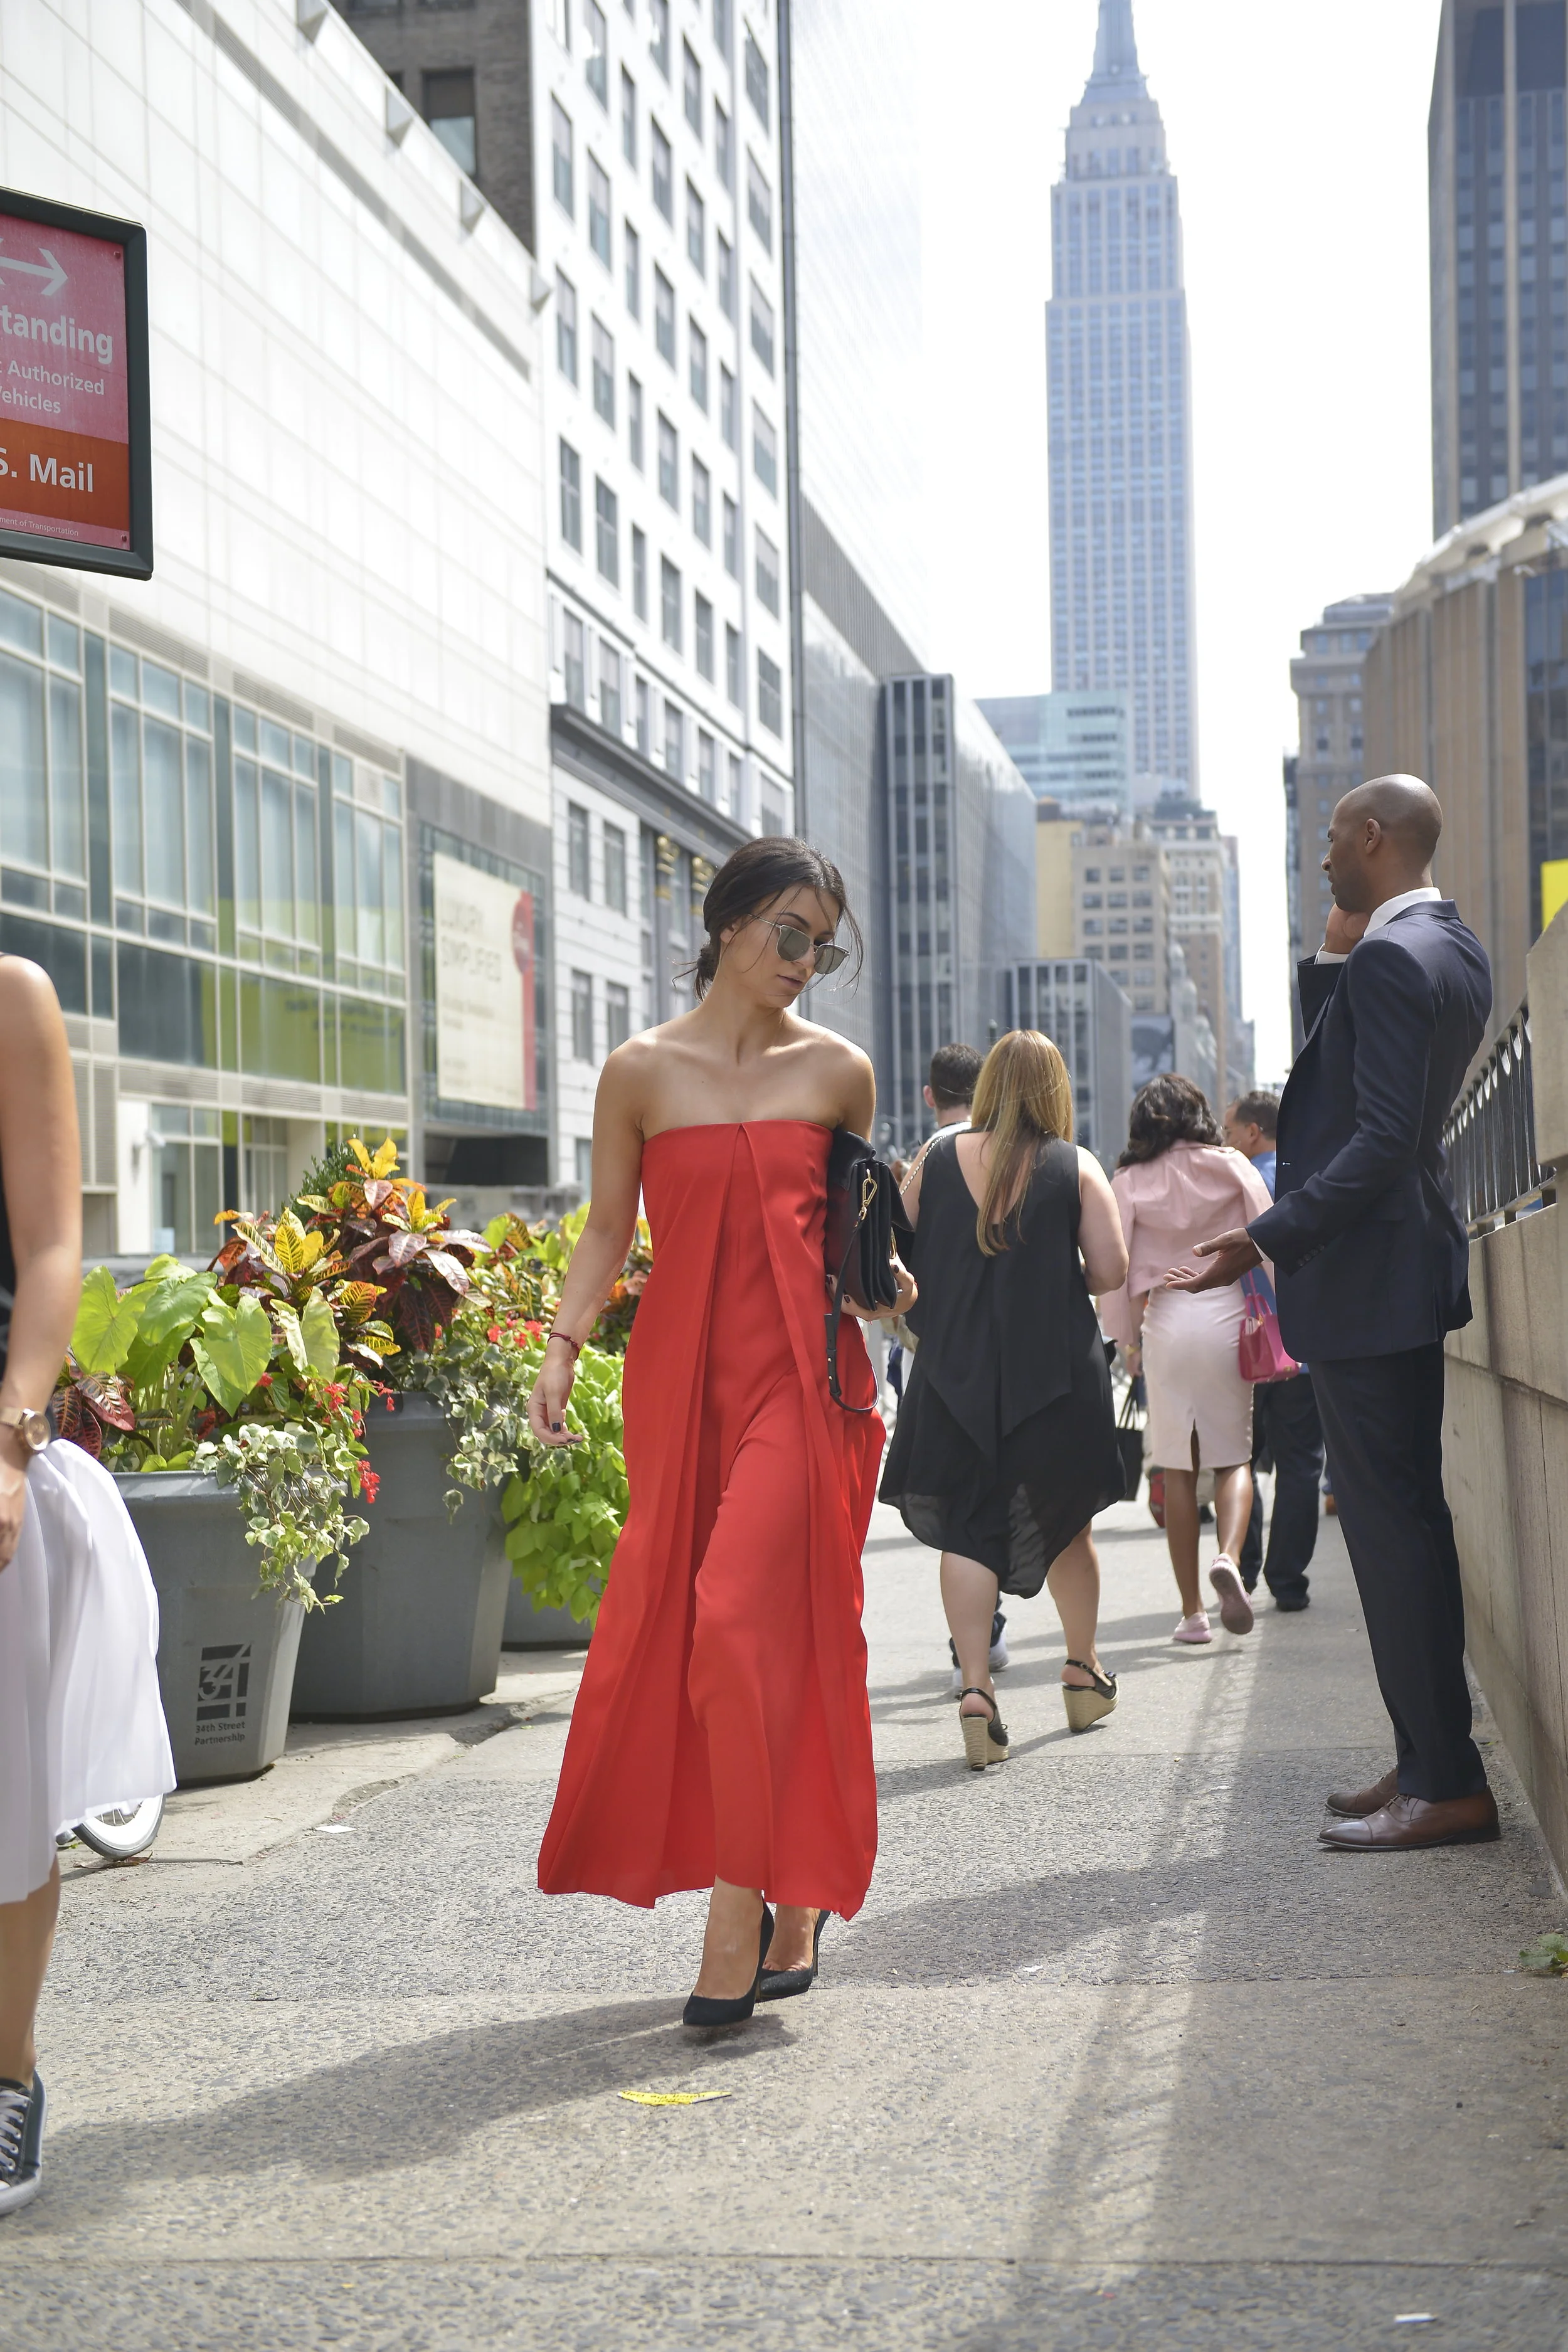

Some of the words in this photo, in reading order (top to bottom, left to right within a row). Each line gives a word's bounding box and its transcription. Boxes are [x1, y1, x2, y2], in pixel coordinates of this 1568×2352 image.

[8, 359, 105, 396] Authorized
[0, 386, 61, 414] ehicles
[29, 453, 93, 493] Mail
[29, 521, 79, 537] Transportation
[194, 1732, 246, 1745] Partnership
[196, 1723, 216, 1734] 34th
[218, 1721, 246, 1731] Street
